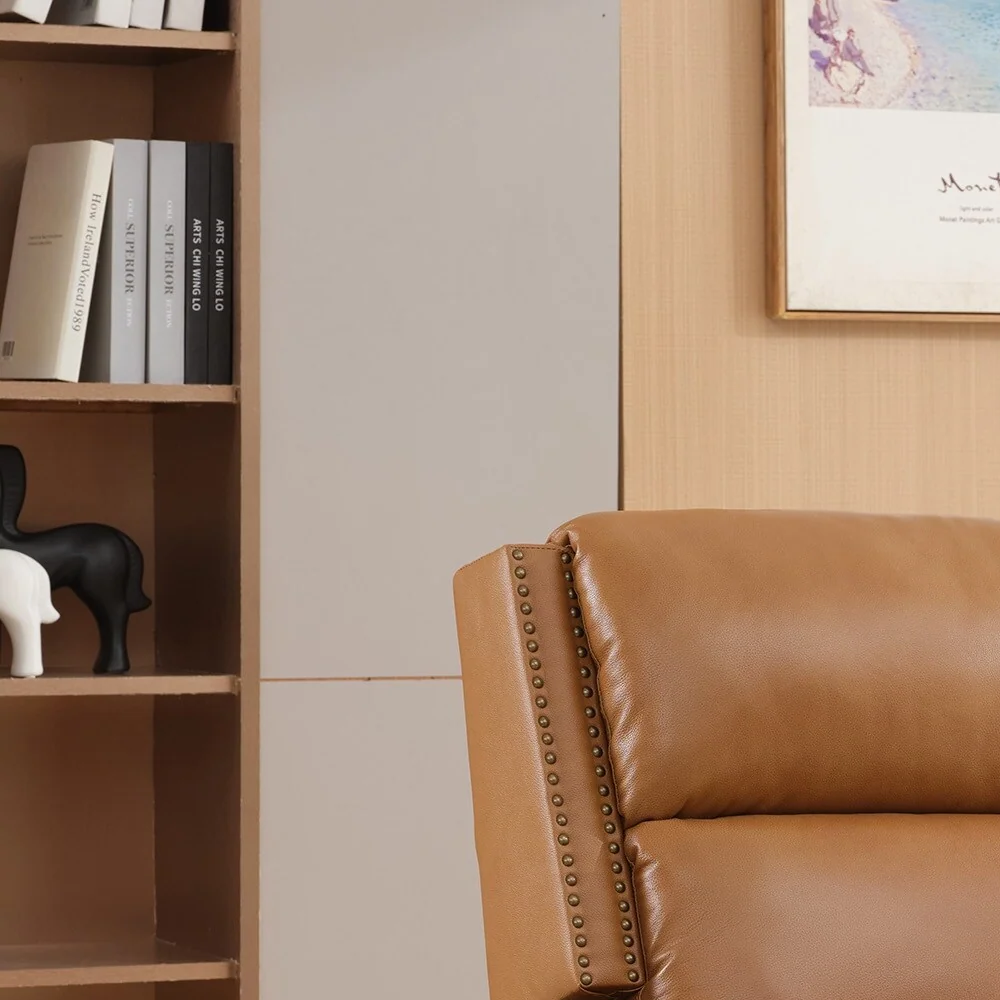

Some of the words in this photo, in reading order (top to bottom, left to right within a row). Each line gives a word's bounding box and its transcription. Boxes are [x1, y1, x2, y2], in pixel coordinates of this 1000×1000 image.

[89, 193, 102, 220] How
[192, 218, 202, 244] ARTS
[215, 218, 225, 244] ARTS
[125, 223, 135, 294] SUPERIOR
[164, 224, 175, 295] SUPERIOR
[192, 248, 202, 266] CHI
[215, 248, 225, 266] CHI
[192, 268, 201, 296] WING
[215, 268, 224, 296] WING
[192, 298, 201, 312] LO
[215, 298, 224, 312] LO
